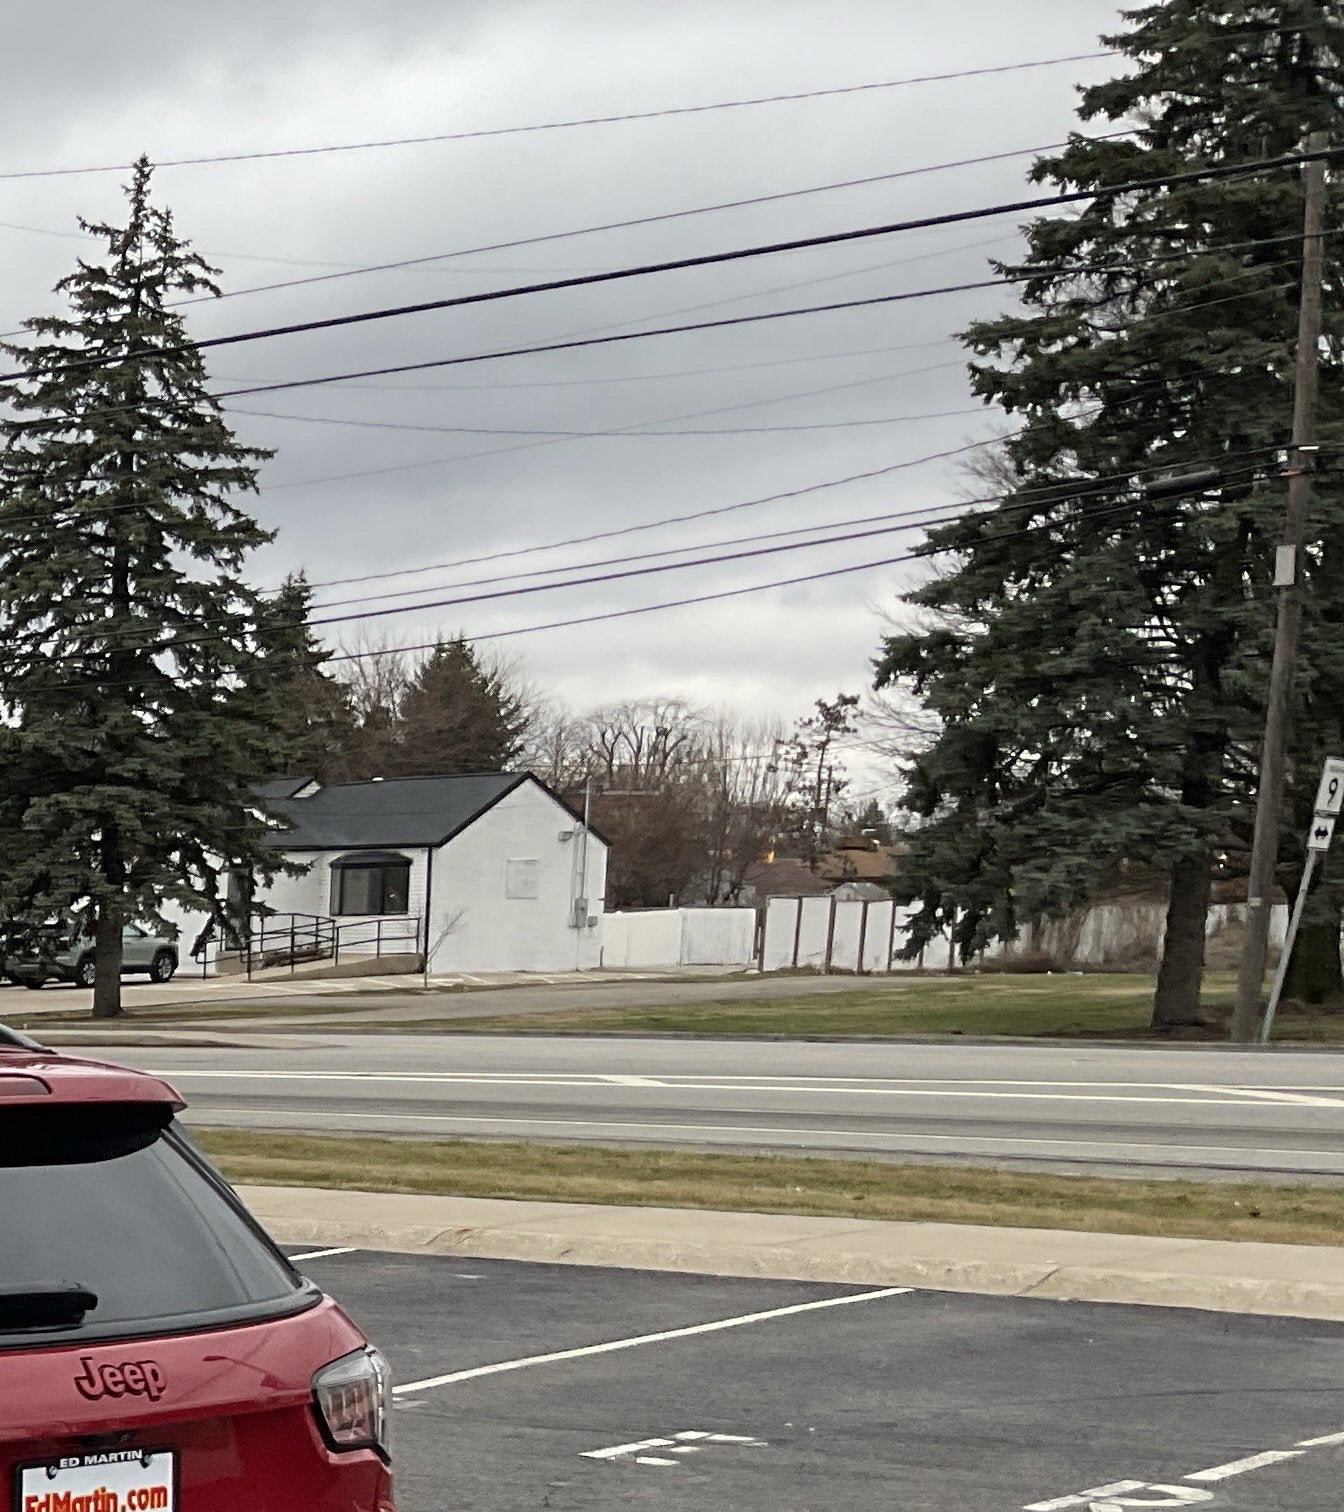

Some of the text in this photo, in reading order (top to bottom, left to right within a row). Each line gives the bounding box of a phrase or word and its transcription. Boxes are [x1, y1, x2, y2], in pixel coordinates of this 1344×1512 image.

[1327, 777, 1339, 808] 9
[74, 1356, 168, 1401] Jeep
[59, 1449, 143, 1469] ED MARTIN
